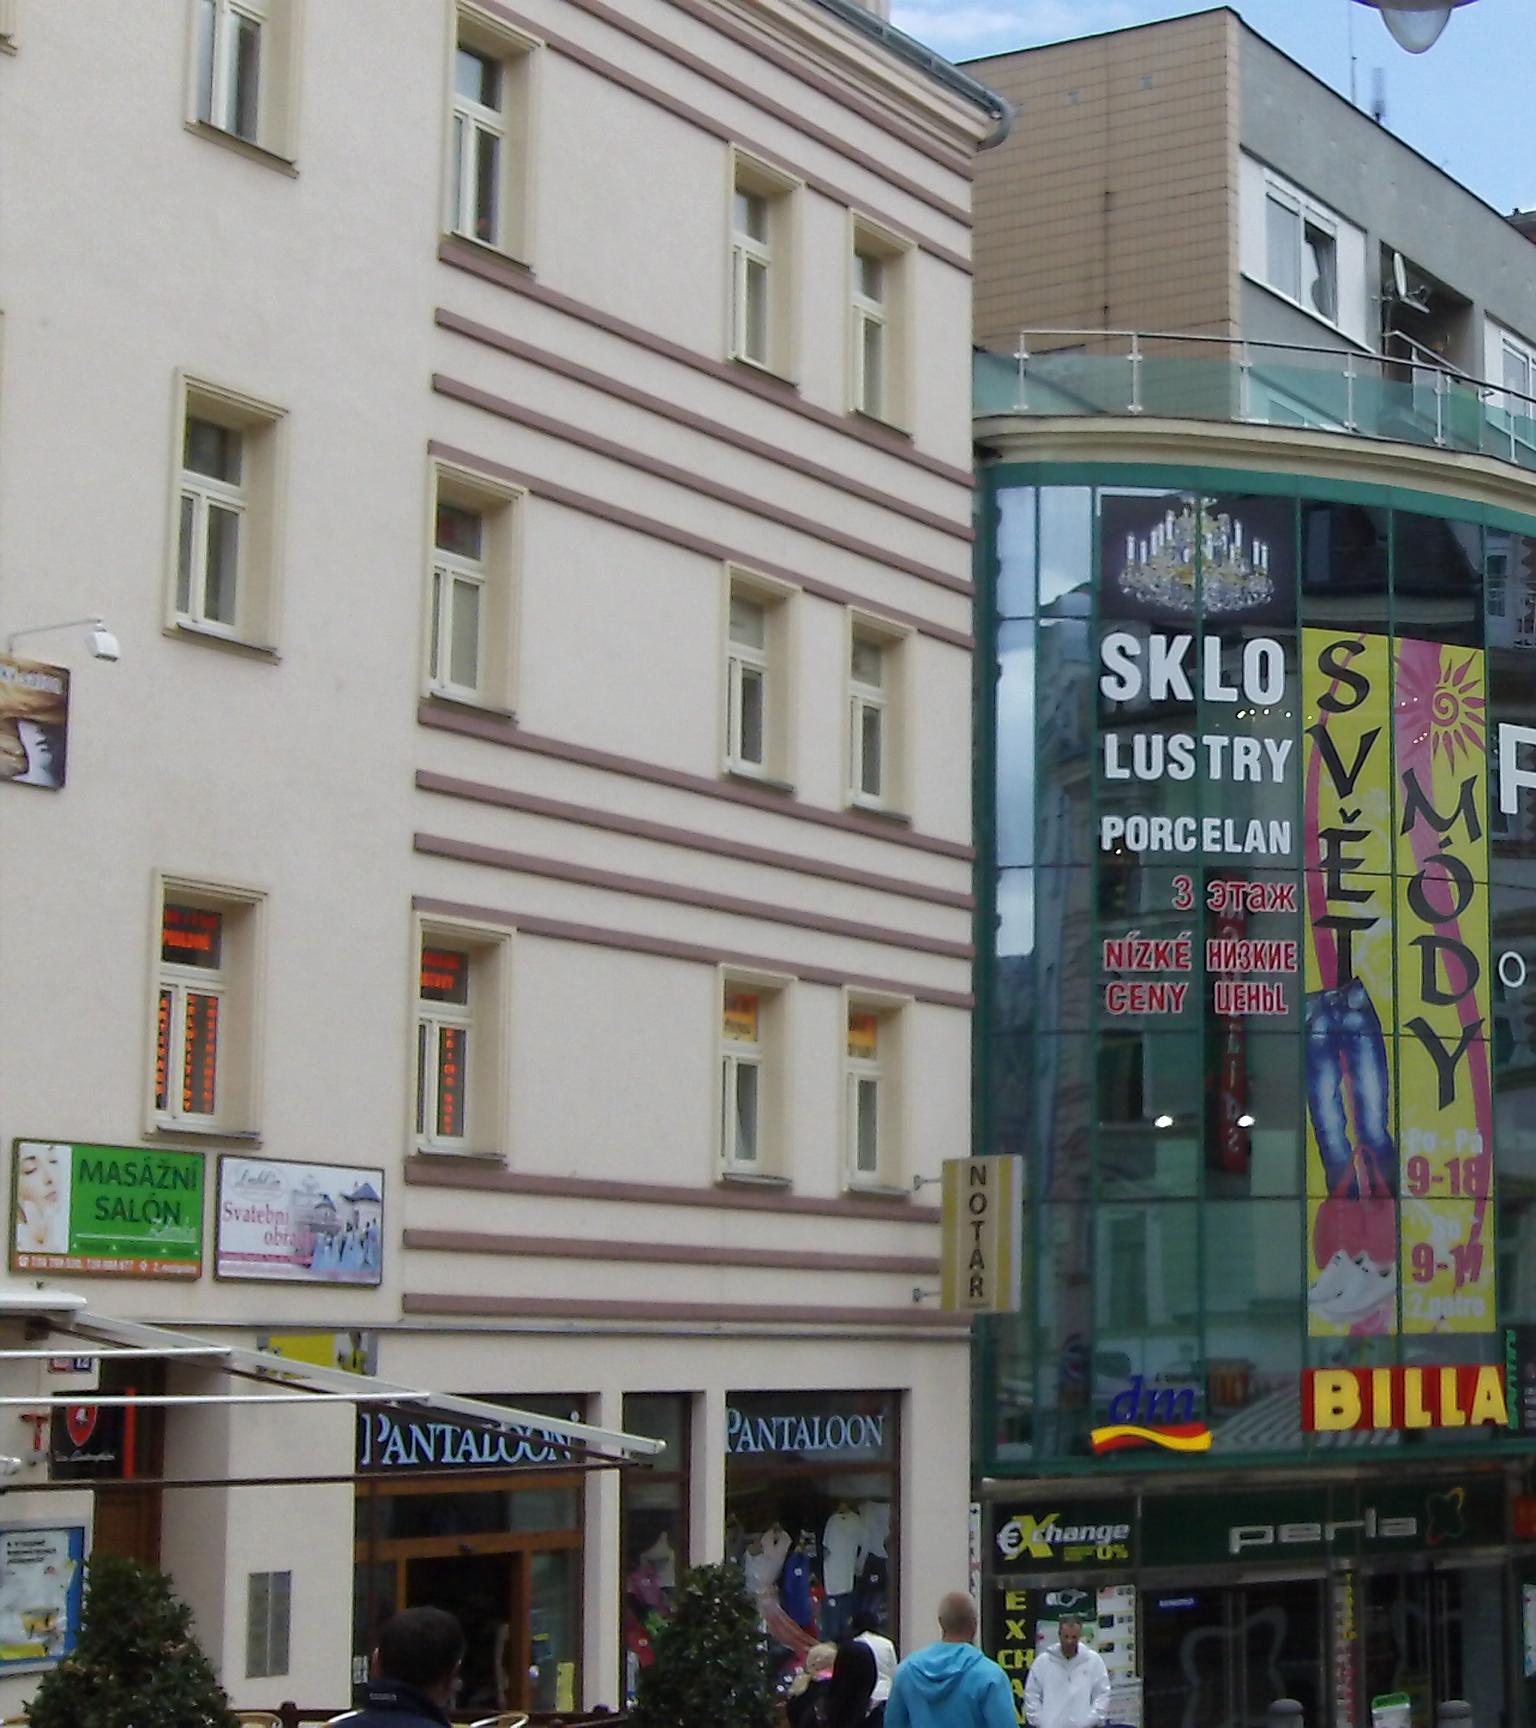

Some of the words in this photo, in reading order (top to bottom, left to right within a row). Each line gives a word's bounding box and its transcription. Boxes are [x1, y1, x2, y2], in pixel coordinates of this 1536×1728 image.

[1100, 631, 1285, 706] SKLO
[1103, 733, 1293, 784] LUSTRY
[1101, 815, 1291, 855] PORCELAN
[1172, 875, 1193, 911] 3
[1103, 930, 1192, 972] NÍZKÉ
[1206, 939, 1297, 973] НИЗКИЕ
[1106, 981, 1187, 1014] CENY
[1214, 983, 1289, 1015] ЦЕНЫ
[78, 1155, 198, 1190] MASÁŽNÍ
[1109, 1374, 1196, 1424] dm
[1313, 1366, 1508, 1431] BILLA
[726, 1407, 884, 1453] PANTALOON
[1229, 1508, 1417, 1555] perla
